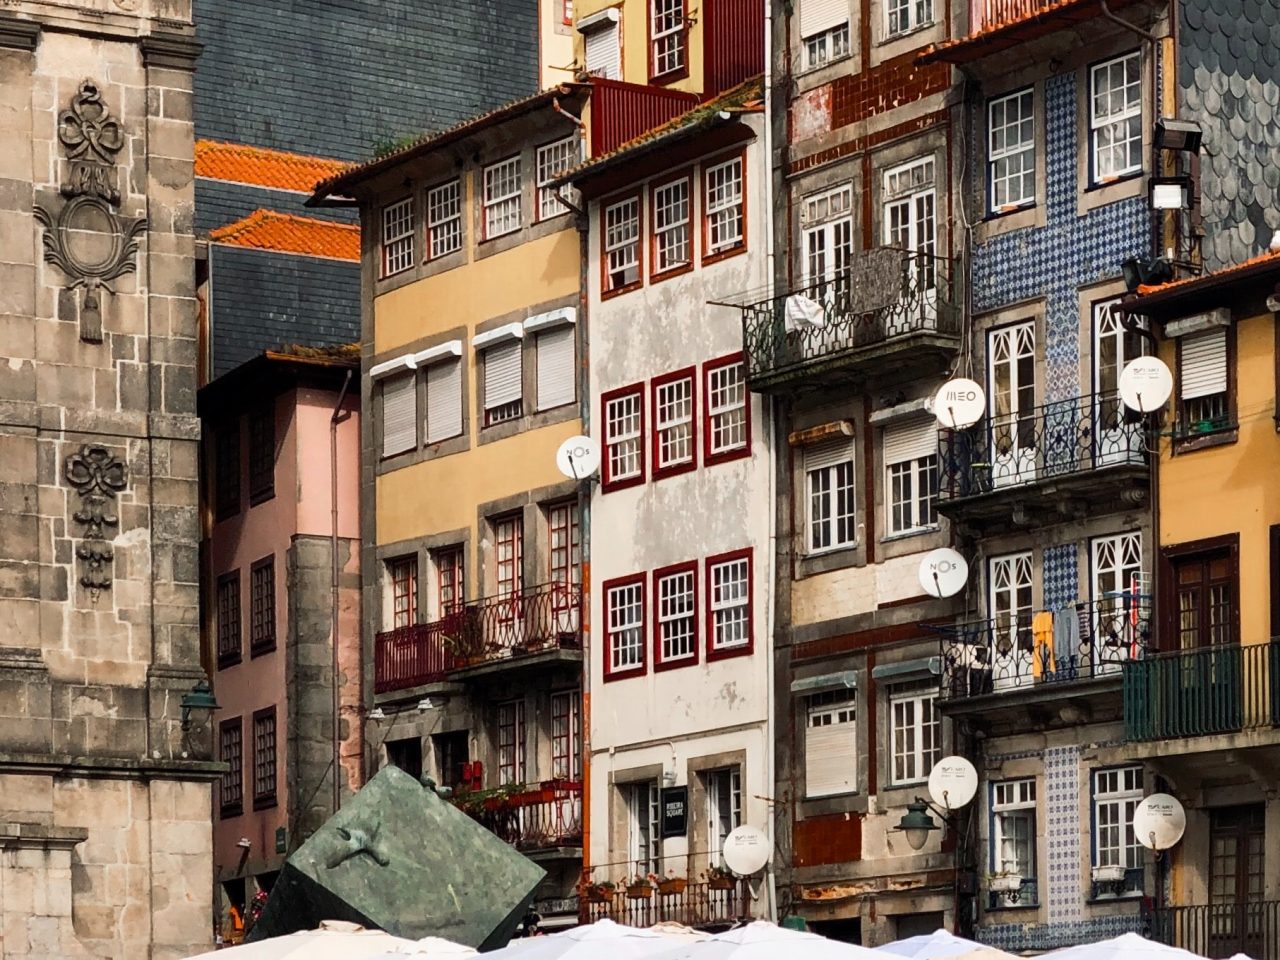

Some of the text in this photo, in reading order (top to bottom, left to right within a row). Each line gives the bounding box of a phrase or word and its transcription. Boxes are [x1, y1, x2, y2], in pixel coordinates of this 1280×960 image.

[946, 391, 976, 401] MEO
[567, 446, 590, 458] NOS
[930, 560, 957, 573] NOS
[666, 809, 683, 818] SQUARE
